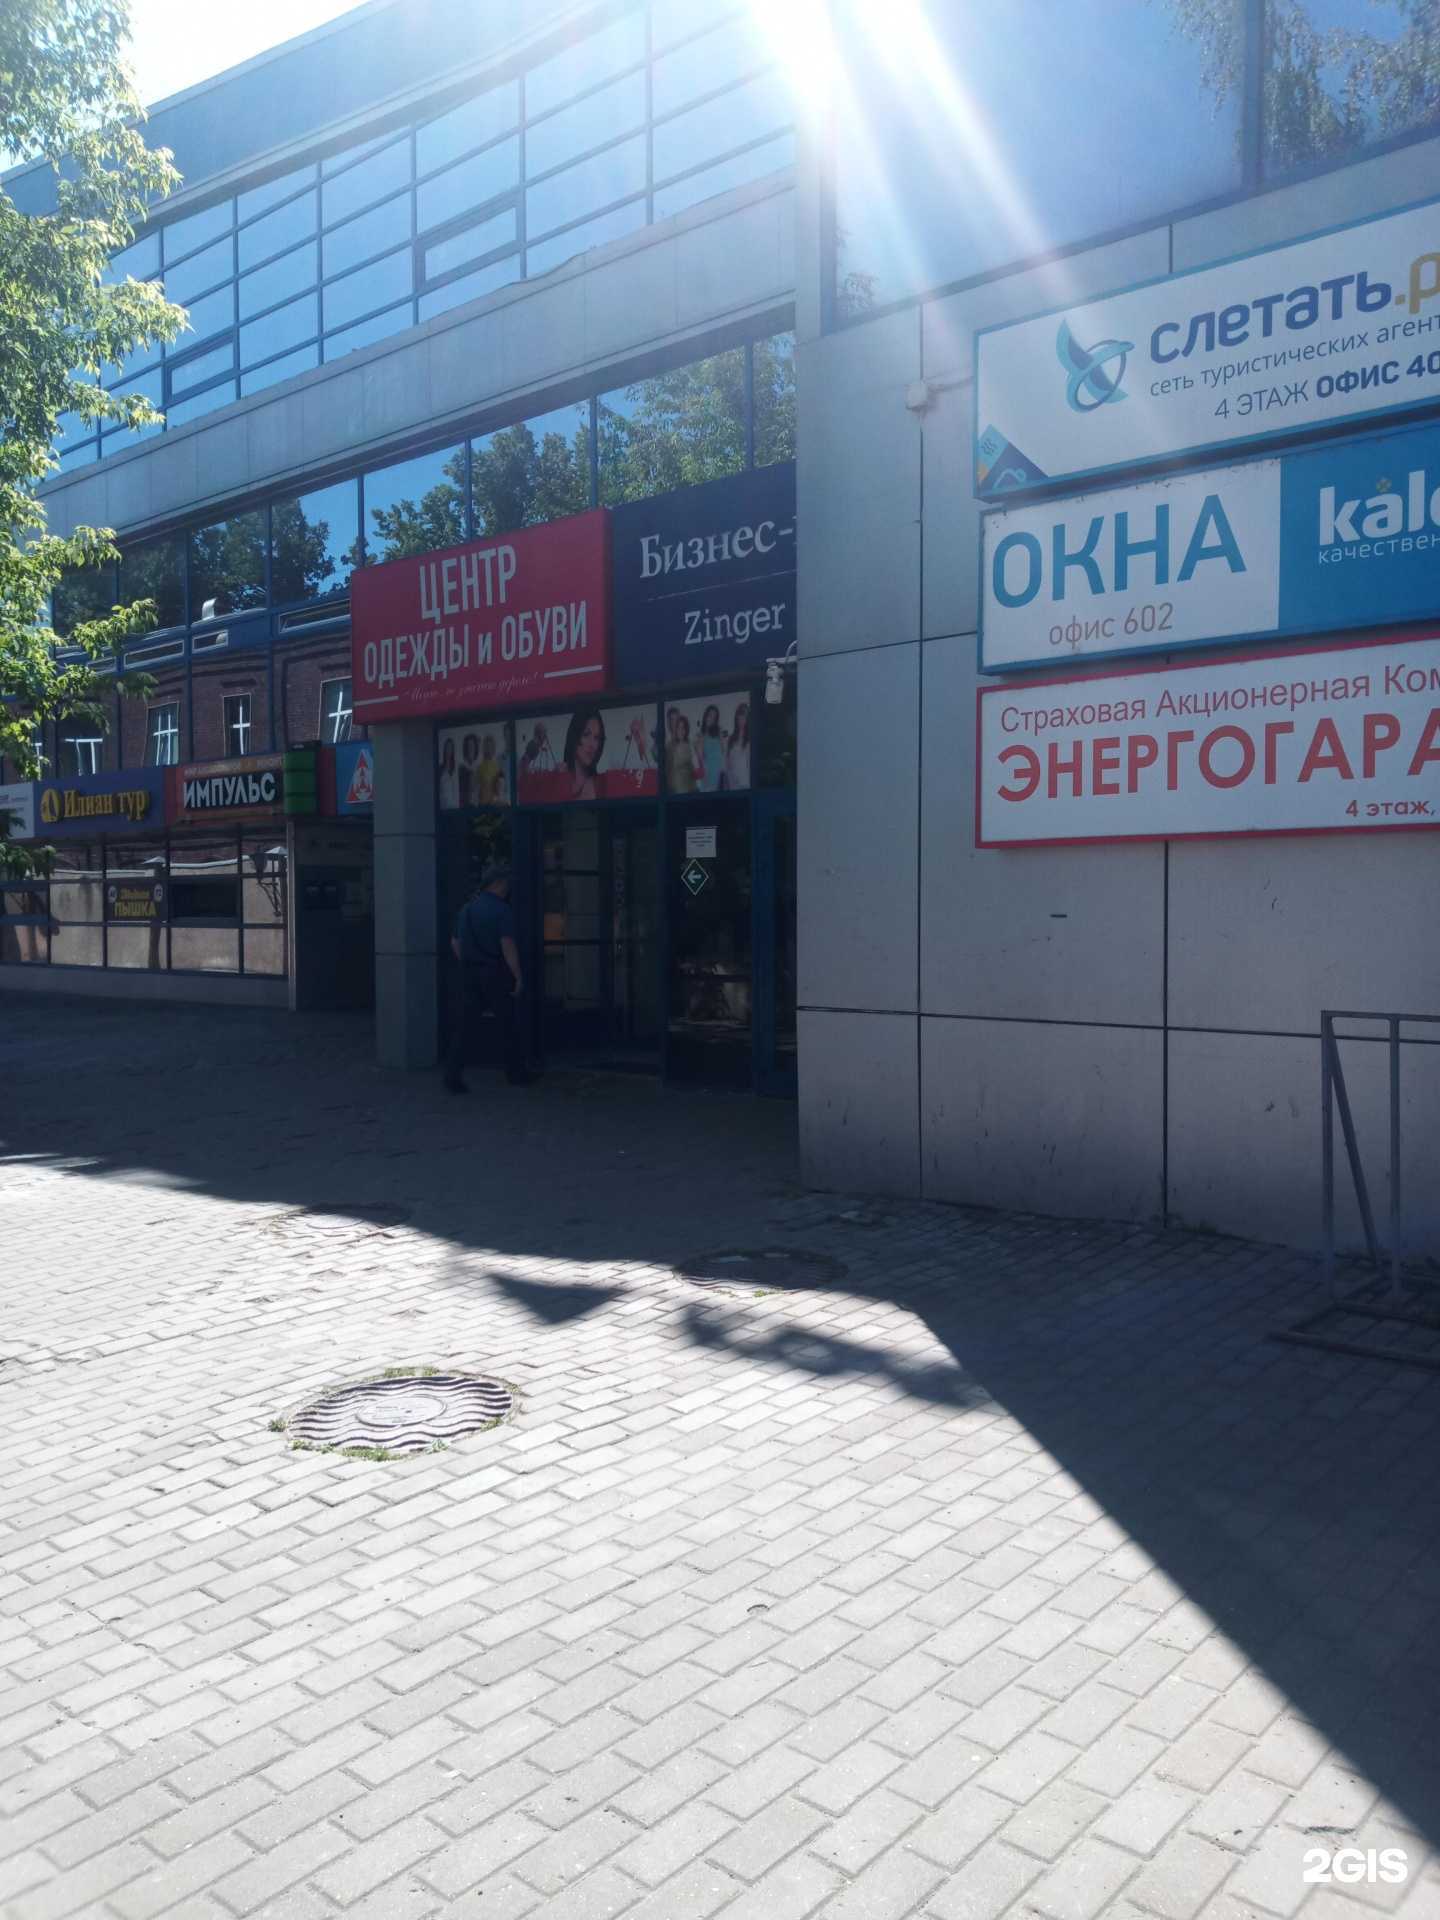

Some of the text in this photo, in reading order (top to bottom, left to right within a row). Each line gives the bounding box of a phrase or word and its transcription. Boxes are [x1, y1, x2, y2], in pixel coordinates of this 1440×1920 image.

[1150, 375, 1194, 397] сеть
[1200, 332, 1369, 389] туристических
[1214, 397, 1230, 420] 4
[1236, 380, 1309, 417] ЭТАЖ
[1315, 360, 1400, 400] ОФИС
[638, 514, 797, 579] Бизнес-
[992, 494, 1247, 609] ОКНА
[418, 543, 516, 625] ЦЕНТР
[363, 623, 470, 689] ОДЕЖДЫ
[477, 635, 493, 665] и
[500, 600, 588, 662] ОБУВИ
[683, 602, 787, 647] Zinger
[1048, 602, 1174, 650] офис 602
[1000, 695, 1146, 737] Страховая
[1155, 673, 1370, 719] Акционерная
[118, 789, 146, 821] тур
[183, 771, 276, 809] ИМПУЛЬС
[1345, 799, 1436, 818] 4 этаж,
